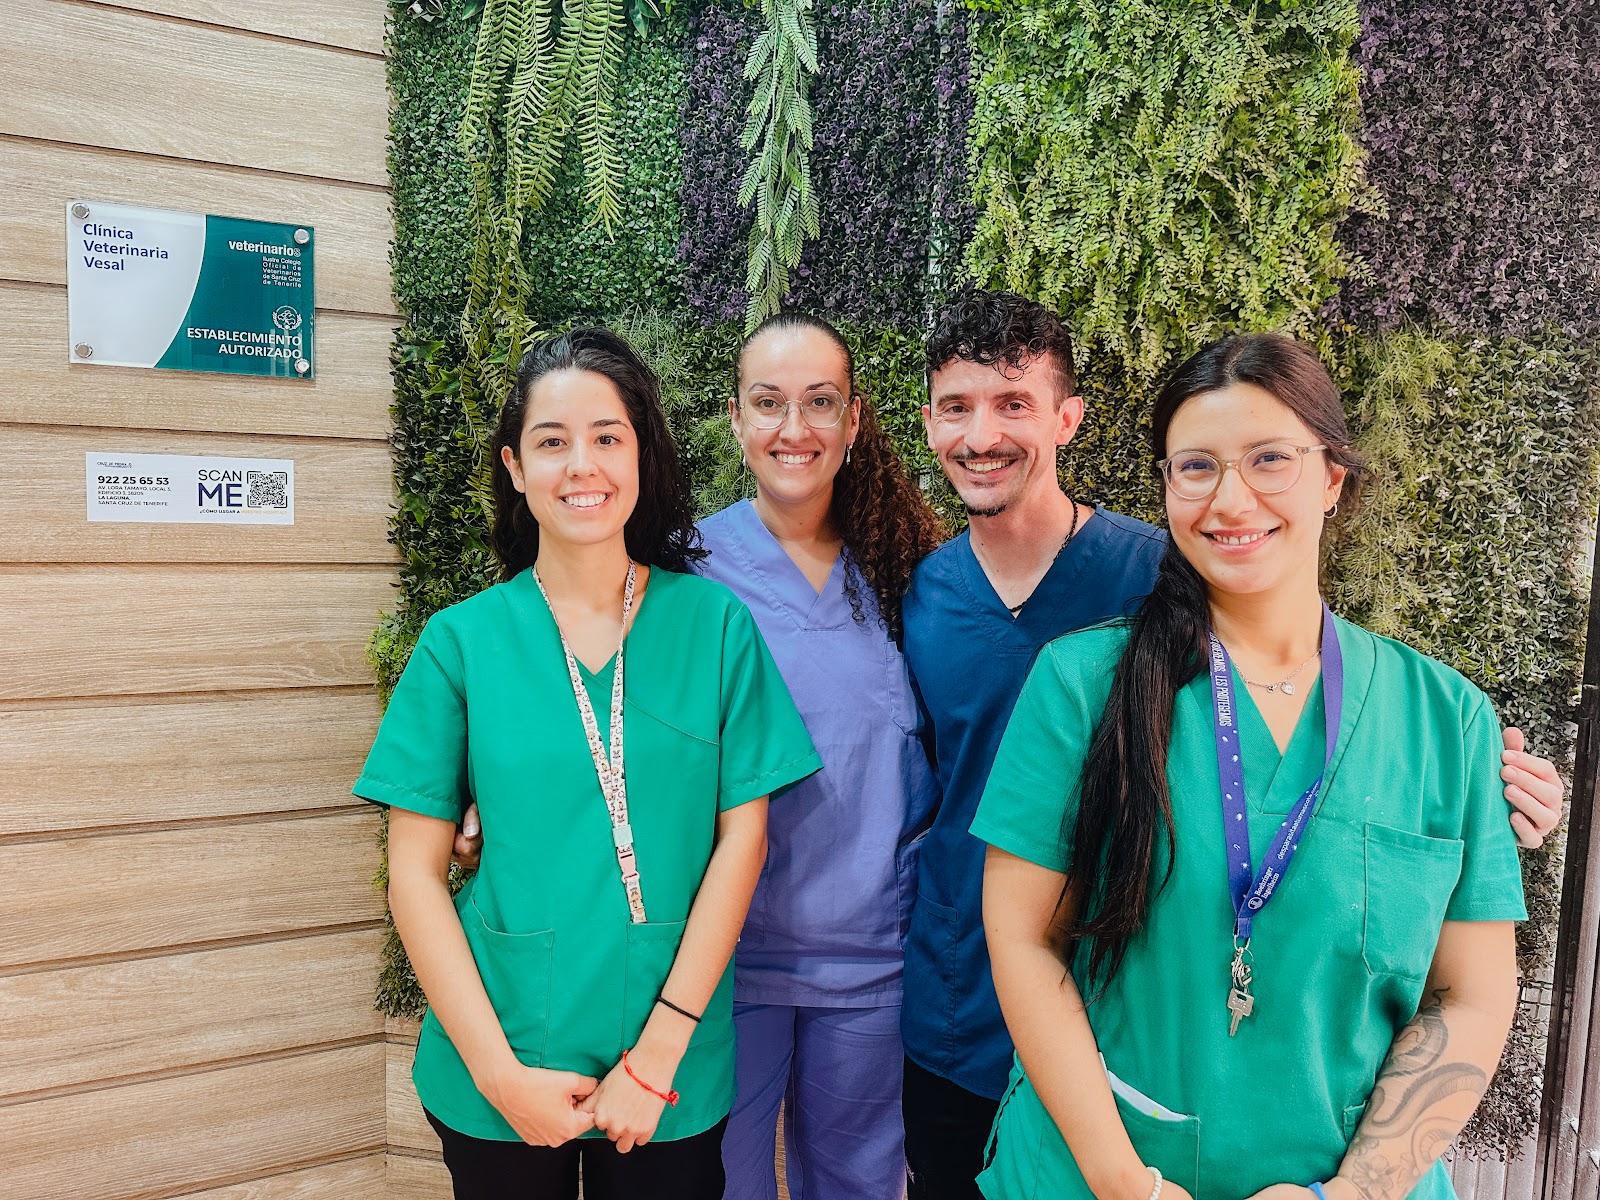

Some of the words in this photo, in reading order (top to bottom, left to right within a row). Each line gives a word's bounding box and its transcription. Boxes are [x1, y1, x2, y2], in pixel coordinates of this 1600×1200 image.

[83, 223, 133, 240] Clínica
[83, 239, 169, 260] Veterinaria
[229, 240, 301, 257] veterinarios
[83, 255, 124, 271] Vesal
[280, 258, 301, 266] Colegio
[262, 268, 301, 277] Veterinarios
[274, 280, 302, 288] Tenerife
[186, 327, 302, 347] ESTABLECIMIENTO
[218, 343, 302, 360] AUTORIZADO
[97, 475, 120, 484] 922
[122, 476, 136, 485] 25
[139, 476, 154, 485] 65
[156, 477, 169, 486] 53
[198, 469, 242, 482] SCAN
[198, 482, 243, 507] ME
[1214, 674, 1229, 688] LES
[1216, 686, 1232, 728] PROTEGEMOS
[1254, 866, 1274, 897] Boehringer
[1260, 872, 1280, 900] Ingelheim
